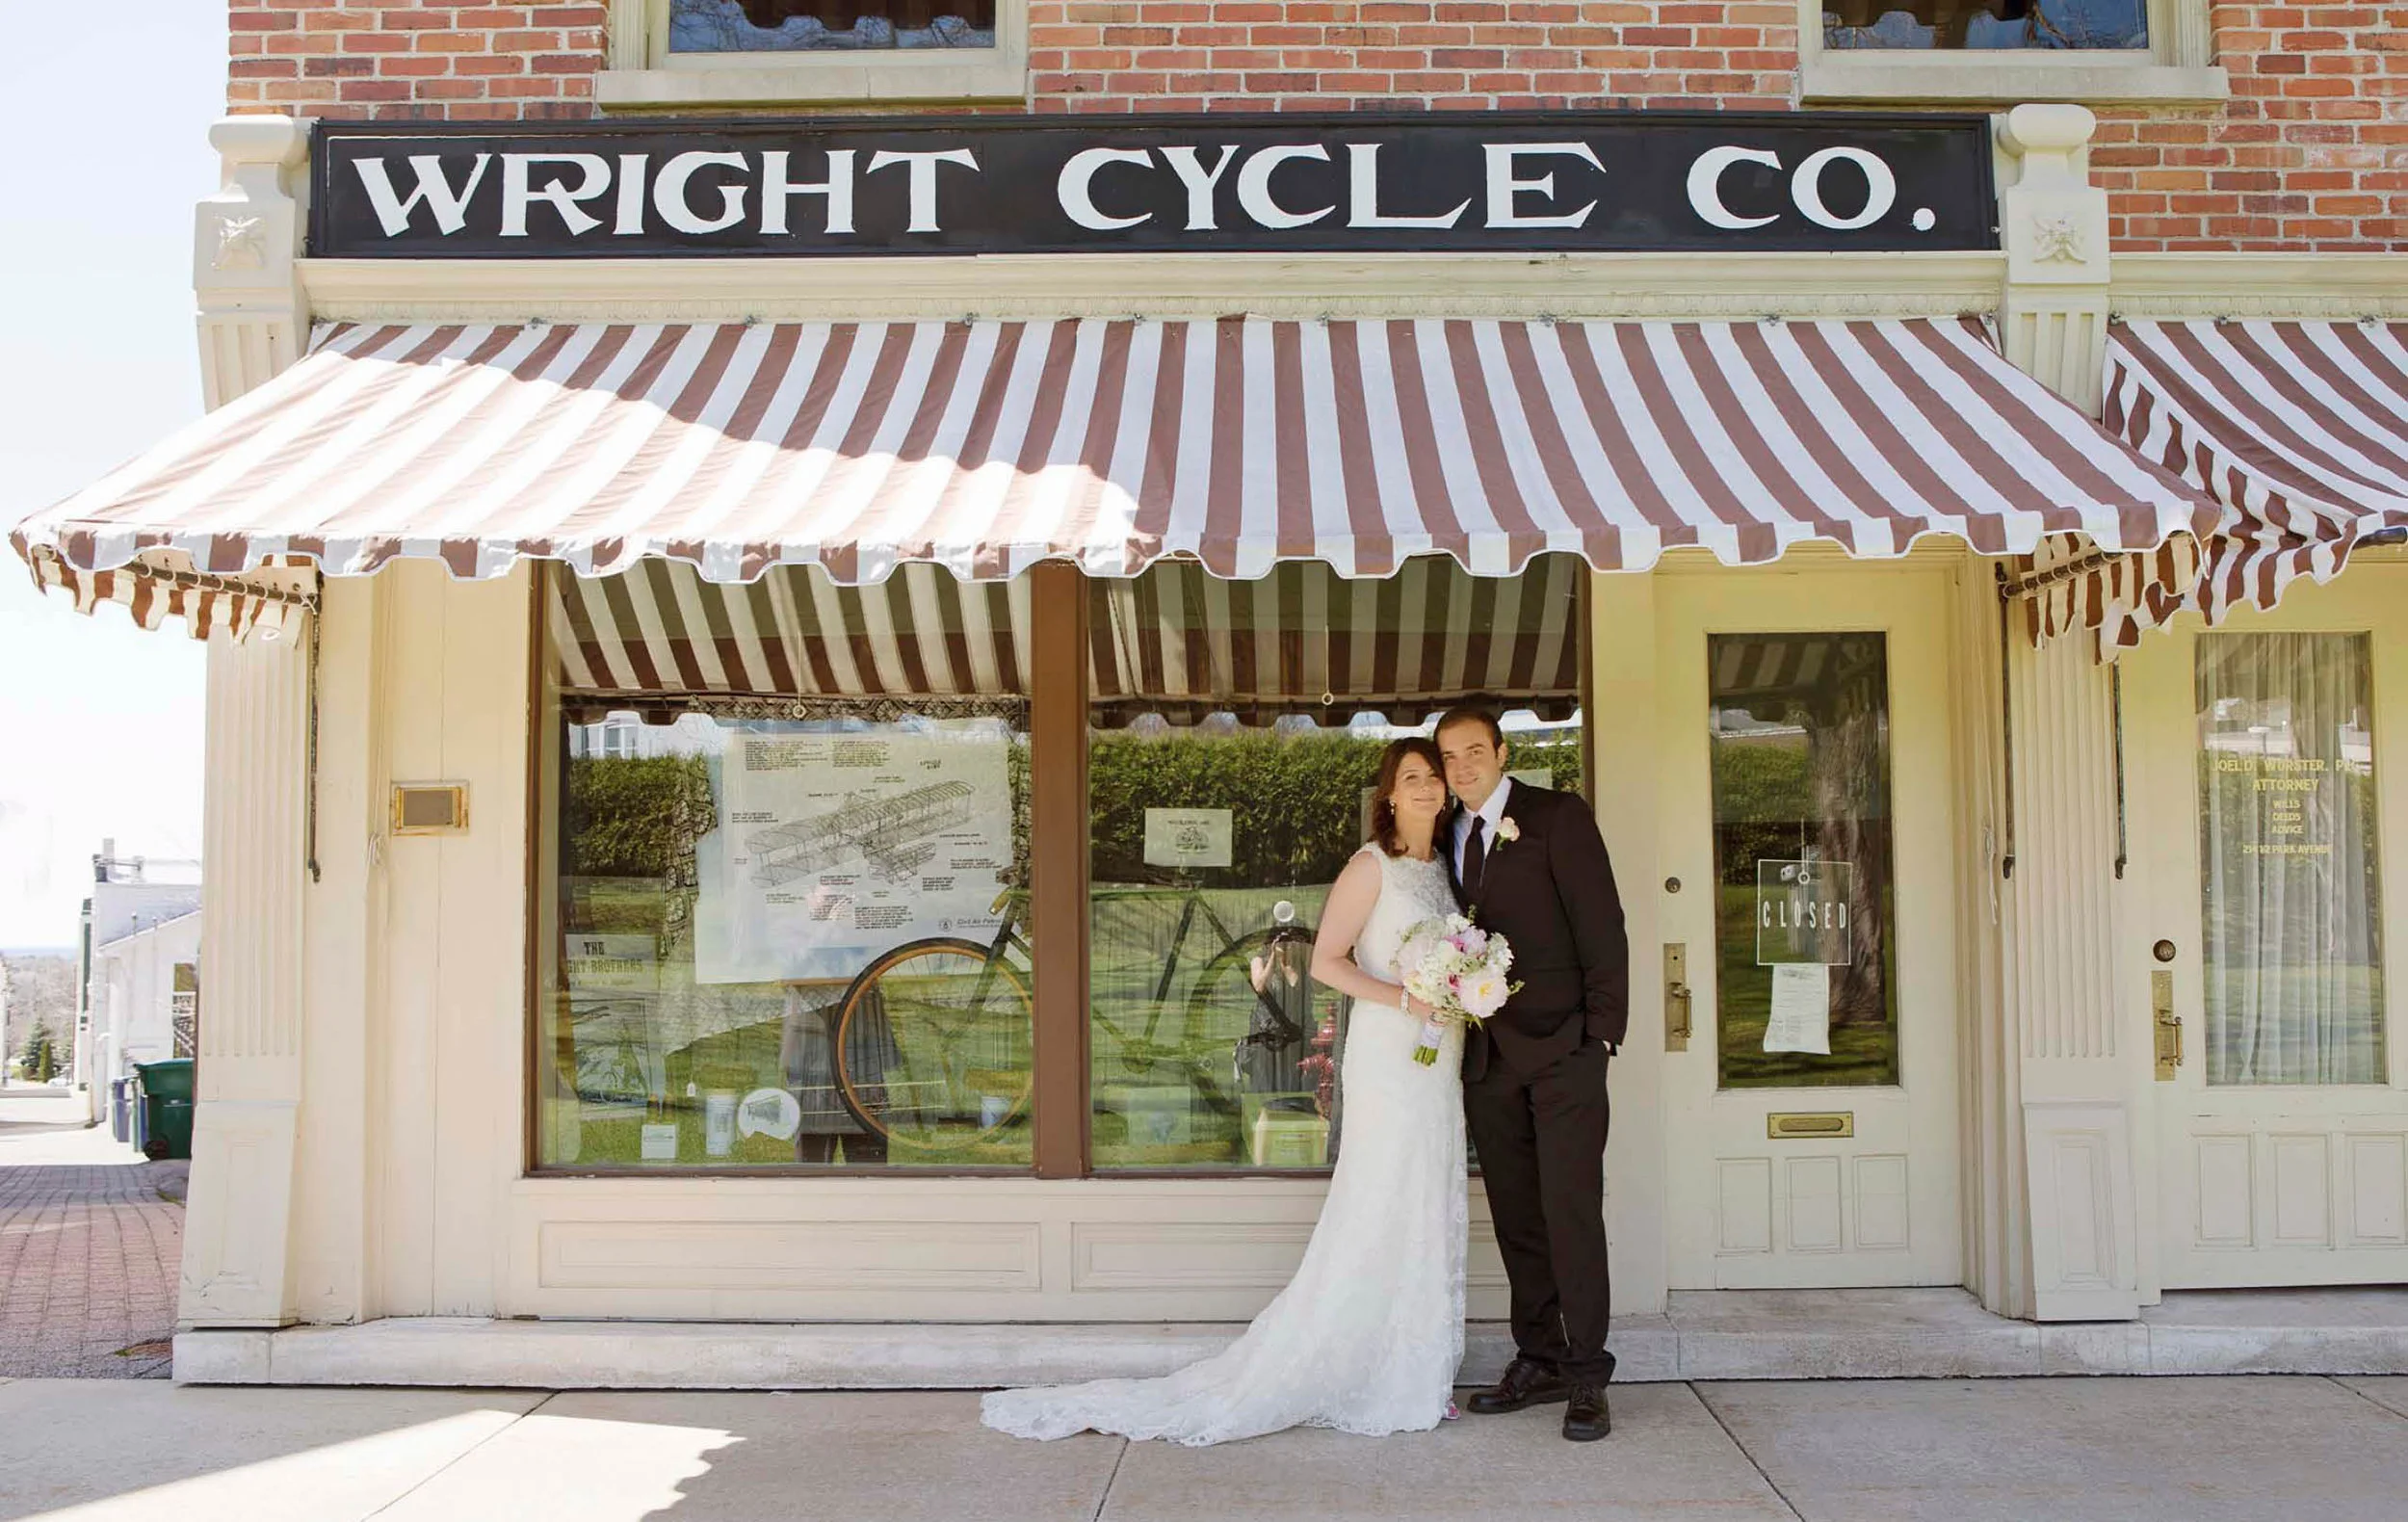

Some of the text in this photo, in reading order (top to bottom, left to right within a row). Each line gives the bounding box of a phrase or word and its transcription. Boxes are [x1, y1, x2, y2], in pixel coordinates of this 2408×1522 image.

[352, 142, 1936, 237] WRIGHT CYCLE CO.
[2252, 777, 2320, 792] ATTORNEY
[1763, 900, 1846, 930] CLOSED
[584, 941, 605, 956] THE
